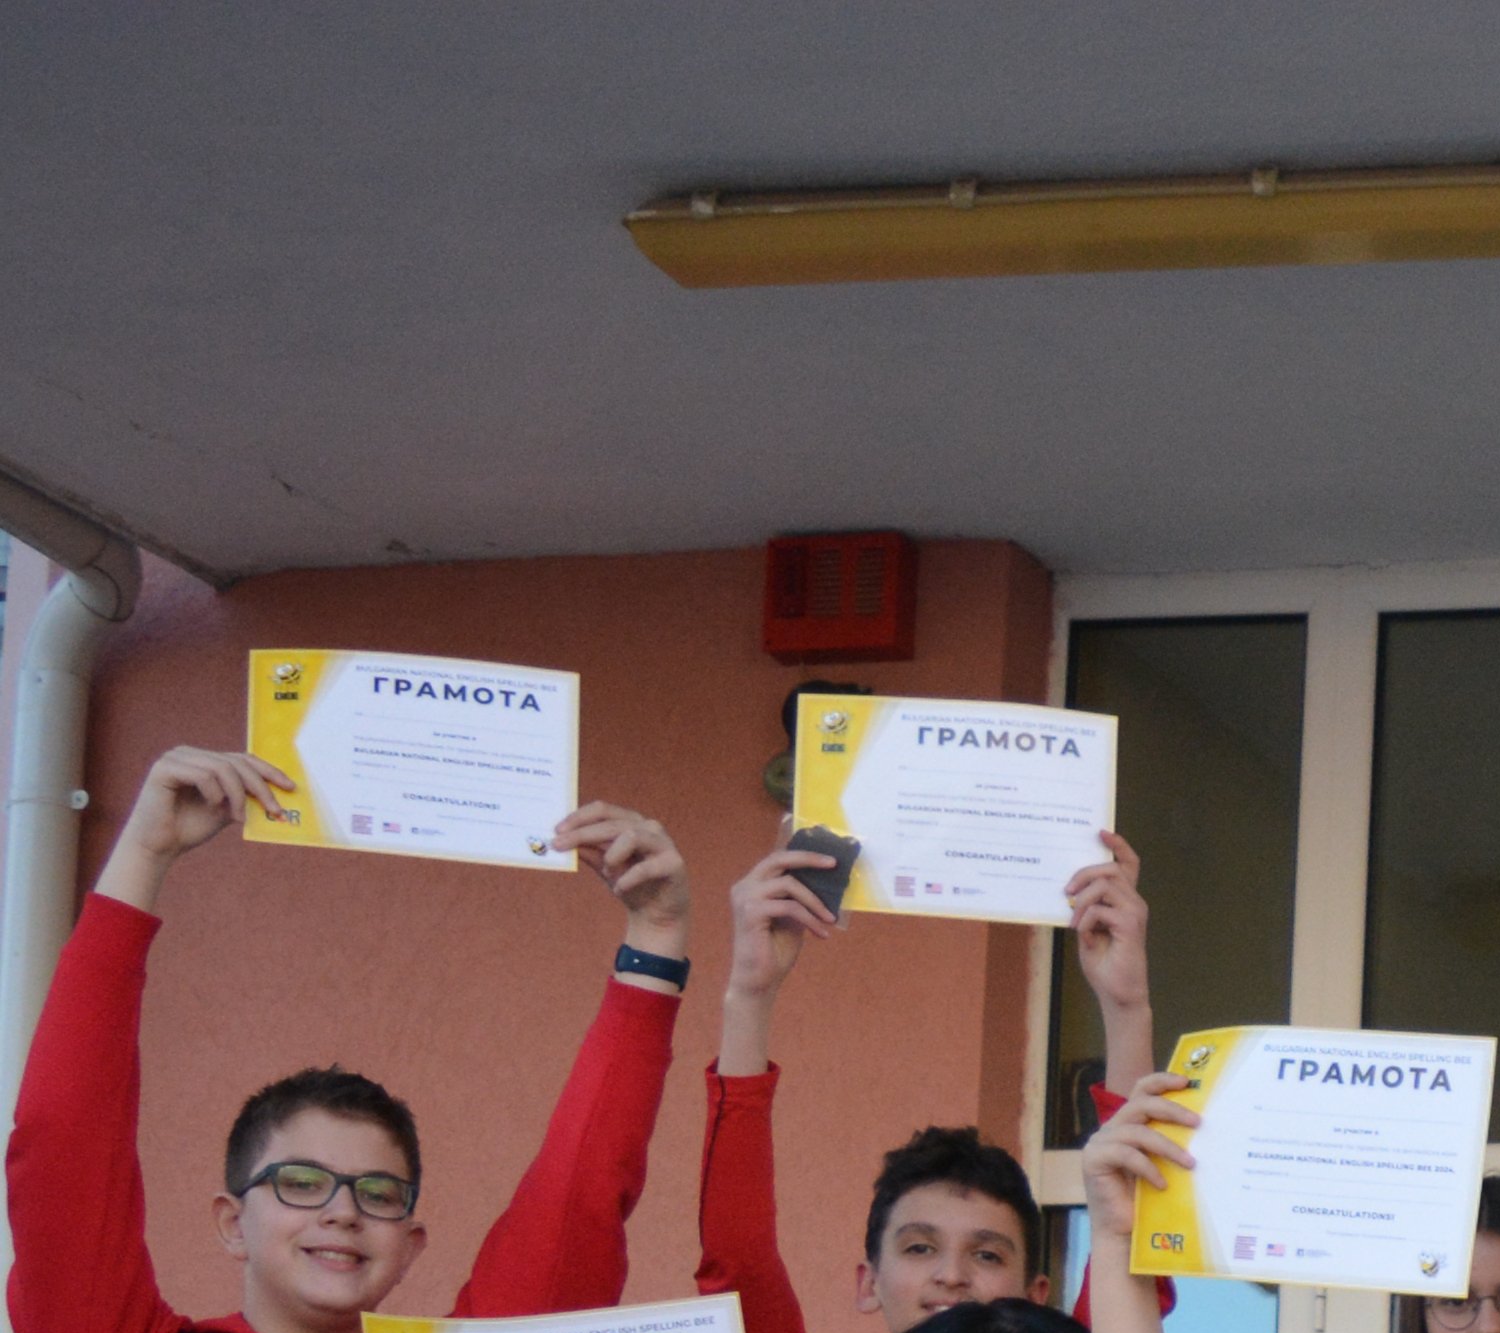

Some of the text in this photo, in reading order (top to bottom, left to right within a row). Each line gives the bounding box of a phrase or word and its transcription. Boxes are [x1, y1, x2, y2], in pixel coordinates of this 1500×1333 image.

[372, 677, 541, 712] ГРАМОТА
[918, 727, 1080, 758] ГРАМОТА
[1277, 1058, 1452, 1092] ГРАМОТА
[1292, 1205, 1395, 1221] CONGRATULATIONS!
